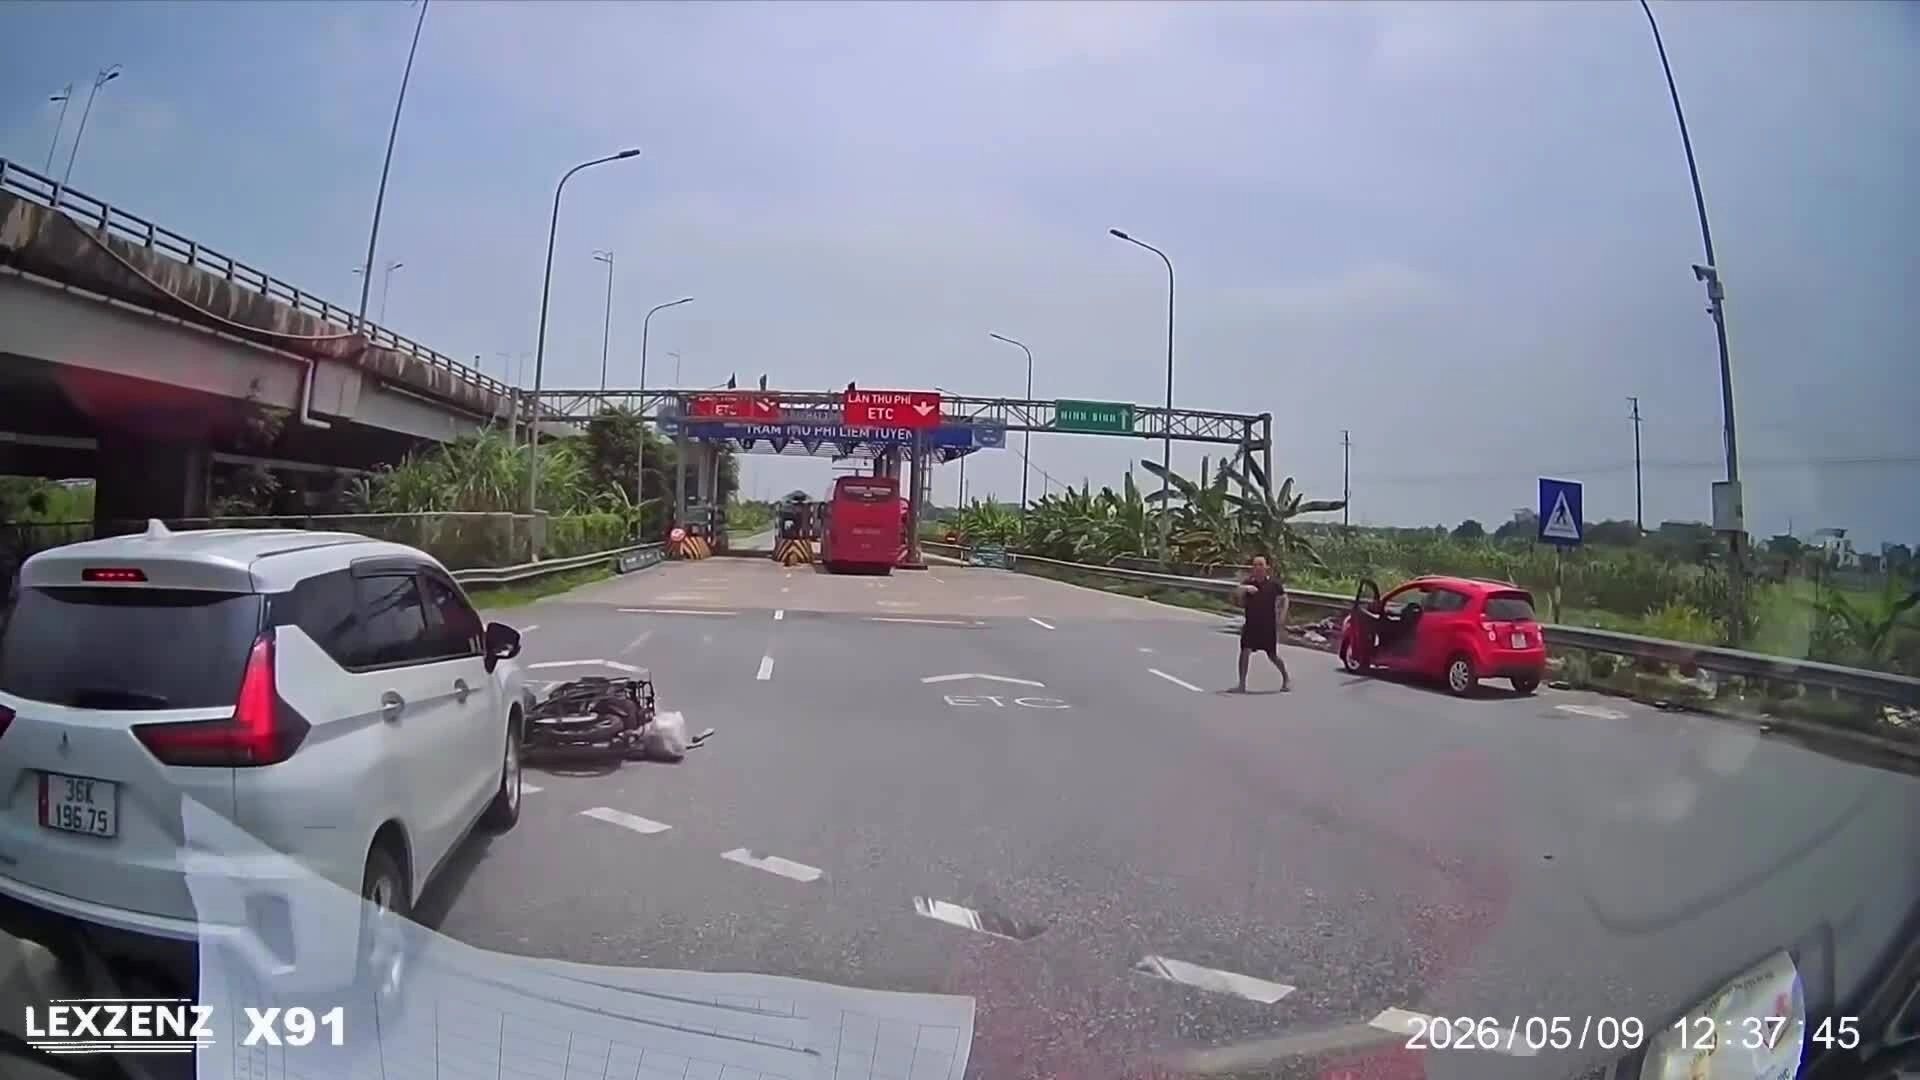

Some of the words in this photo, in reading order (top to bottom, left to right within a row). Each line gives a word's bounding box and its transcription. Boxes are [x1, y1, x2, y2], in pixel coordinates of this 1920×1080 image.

[872, 394, 893, 404] THU
[867, 407, 894, 420] ETC
[943, 695, 1073, 709] ETC
[64, 779, 96, 804] 36K
